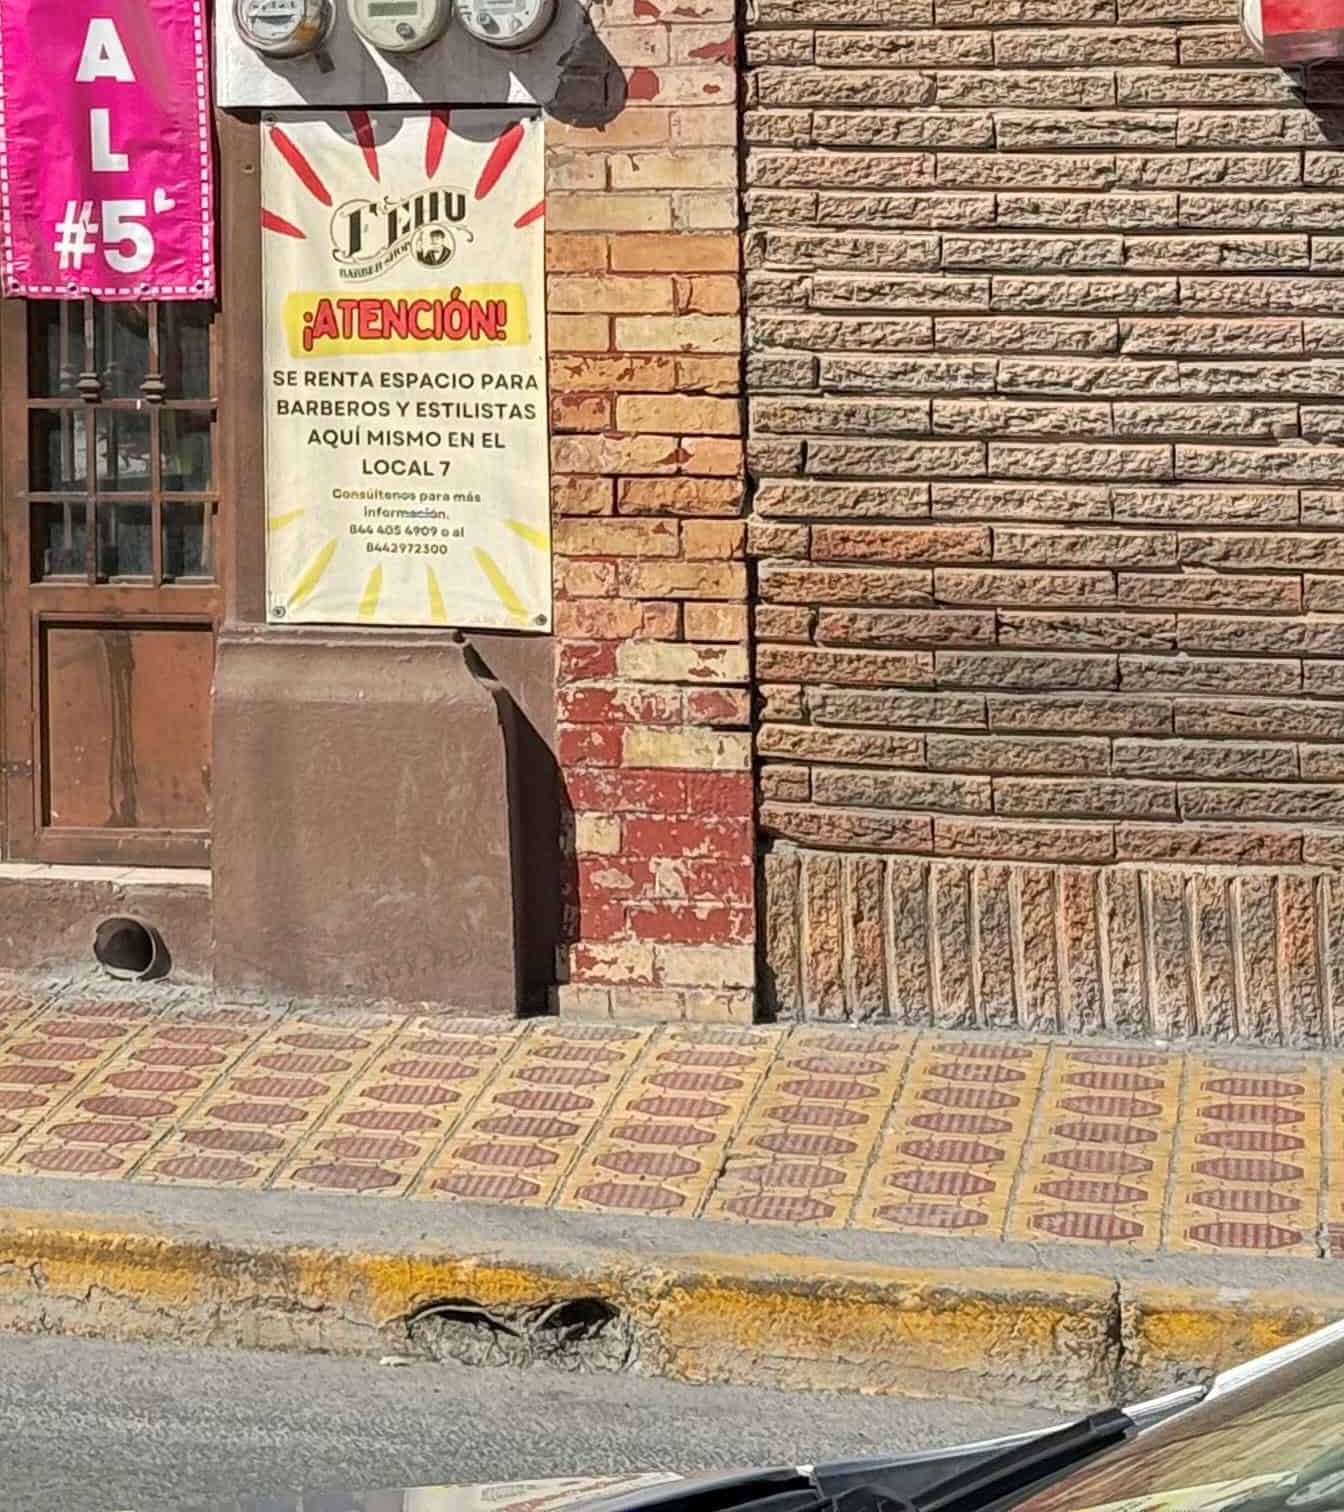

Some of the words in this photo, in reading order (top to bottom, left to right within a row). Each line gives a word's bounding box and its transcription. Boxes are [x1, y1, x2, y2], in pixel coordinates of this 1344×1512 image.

[54, 199, 155, 275] #5
[303, 286, 508, 352] ¡ATENCIÓN!
[273, 370, 298, 386] SE
[304, 371, 374, 388] RENTA
[380, 372, 475, 389] ESPACIO
[481, 373, 539, 390] PARA
[276, 399, 391, 417] BARBEROS
[396, 400, 410, 417] Y
[416, 402, 537, 420] ESTILISTAS
[307, 426, 361, 448] AQUÍ
[367, 430, 441, 447] MISMO
[448, 431, 475, 448] EN
[482, 432, 506, 449] EL
[362, 459, 434, 476] LOCAL
[439, 461, 451, 477] 7
[419, 492, 450, 504] para
[453, 490, 481, 503] más
[377, 525, 401, 536] 405
[405, 526, 438, 537] 4909
[441, 529, 449, 537] o
[452, 527, 464, 538] al
